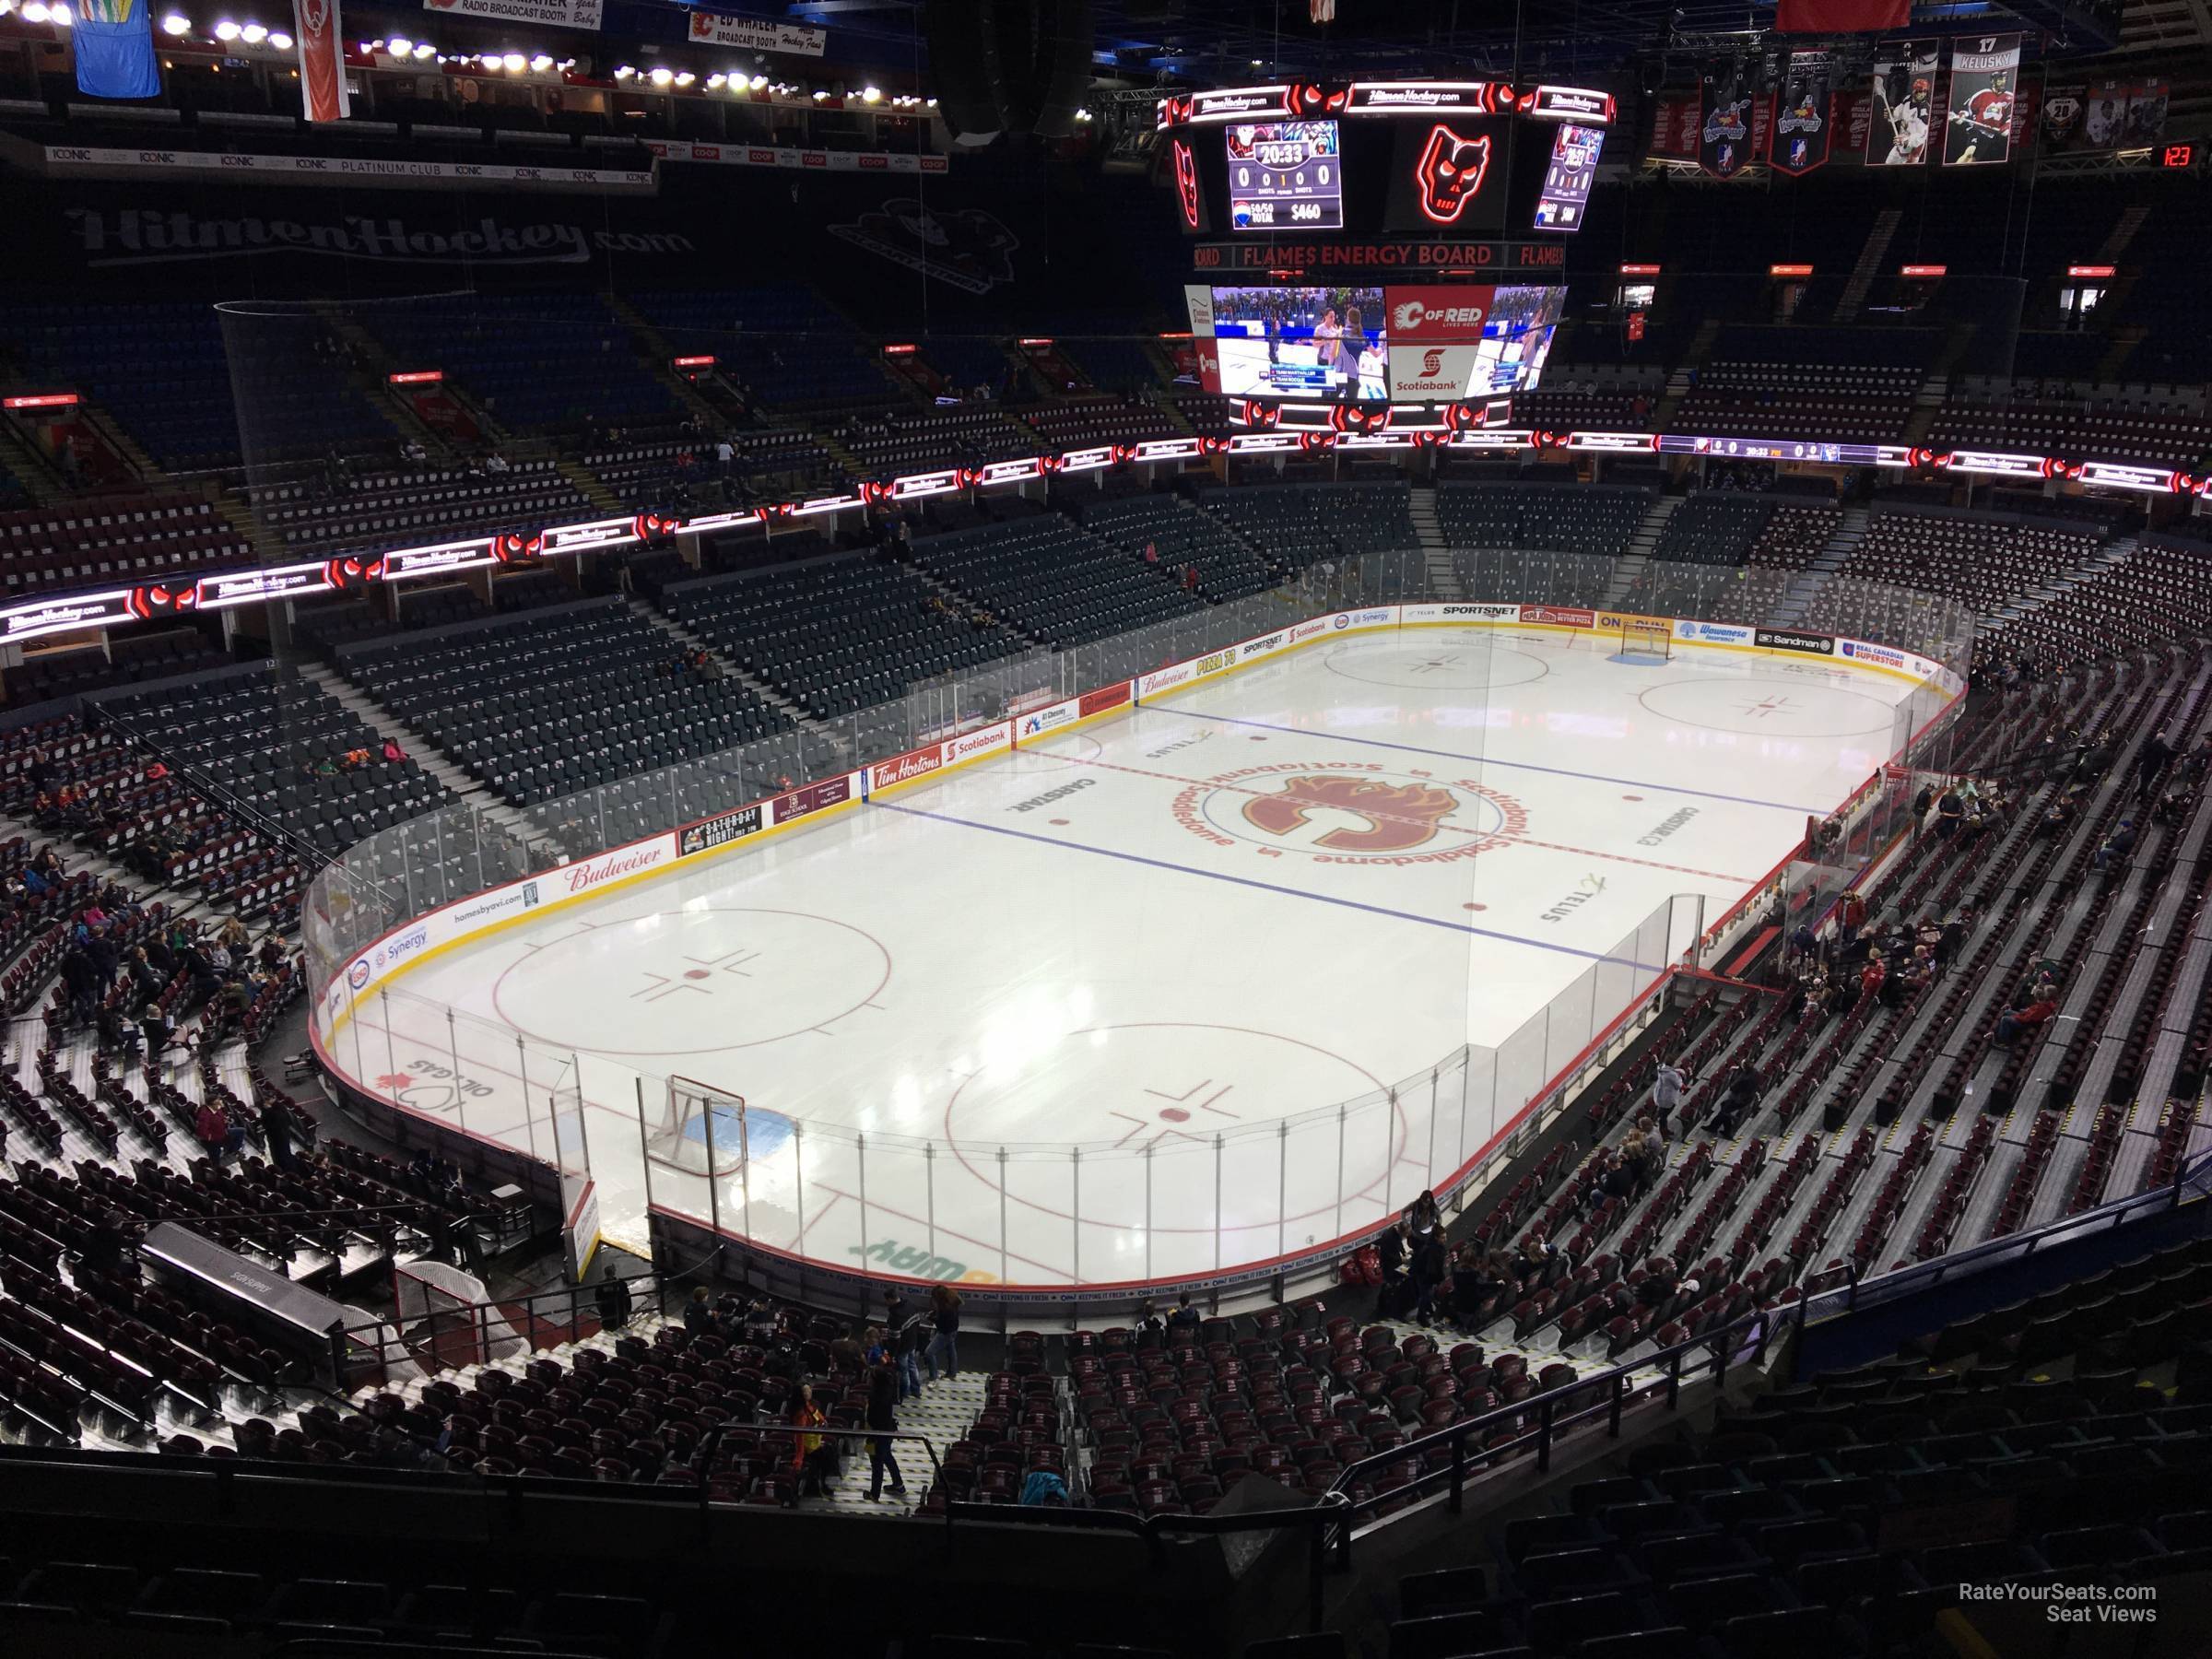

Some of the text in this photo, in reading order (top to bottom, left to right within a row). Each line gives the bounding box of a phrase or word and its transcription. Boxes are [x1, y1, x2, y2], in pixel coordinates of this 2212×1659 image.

[462, 0, 489, 13] RADIO
[489, 3, 539, 21] BROADCAST
[540, 8, 567, 23] BOOTH
[716, 31, 756, 46] BROADCAST
[757, 36, 778, 48] BOOTH
[1978, 38, 1997, 53] 17
[1960, 54, 2011, 69] KELUSKY
[1368, 89, 1459, 105] HitmenHockey.com
[53, 148, 91, 161] ICONIC
[140, 151, 174, 164] ICONIC
[693, 148, 719, 158] CO-OP
[750, 151, 774, 161] CO-OP
[1261, 145, 1303, 164] 20:33
[221, 155, 254, 168] ICONIC
[296, 158, 327, 170] ICONIC
[341, 161, 441, 176] PLATINUM CLUB
[923, 159, 946, 170] CO-OP
[1238, 167, 1250, 187] 0
[1263, 172, 1271, 186] 0
[1296, 171, 1304, 185] 0
[1318, 164, 1330, 185] 0
[1251, 203, 1322, 221] 50/50 $460
[1251, 213, 1275, 223] TOTAL
[1243, 245, 1317, 266] FLAMES
[1321, 245, 1413, 265] ENERGY
[1418, 245, 1491, 265] BOARD
[1425, 310, 1445, 321] OF
[1444, 307, 1483, 323] RED
[1396, 381, 1456, 391] Scotiabank
[1362, 612, 1389, 623] Synergy
[1442, 606, 1517, 616] SPORTSNET
[1297, 622, 1326, 638] Scotiabank
[1601, 617, 1621, 628] ON
[1700, 624, 1747, 638] Wawanesa
[1243, 634, 1283, 655] SPORTSNET
[1774, 635, 1819, 649] Sandman
[1855, 652, 1903, 668] SUPERSTORE
[1856, 644, 1905, 661] REAL CANADIAN
[1196, 648, 1236, 676] PIZZA 73
[1144, 670, 1189, 693] Budweiser
[959, 730, 1006, 754] Scotiabank
[1146, 739, 1195, 759] TELUS
[876, 756, 940, 787] Tim Hortons
[1172, 762, 1384, 847] Scotiabank Saddledome
[1312, 778, 1533, 867] Scotiabank Saddledome
[707, 827, 735, 847] NIGHT!
[564, 848, 662, 892] Budweiser
[453, 894, 522, 924] homesbyavi.com
[1540, 891, 1594, 924] TELUS
[388, 931, 428, 959] Synergy
[406, 1060, 453, 1079] GAS
[461, 1079, 495, 1097] OIL
[248, 1278, 273, 1293] SUPPLY
